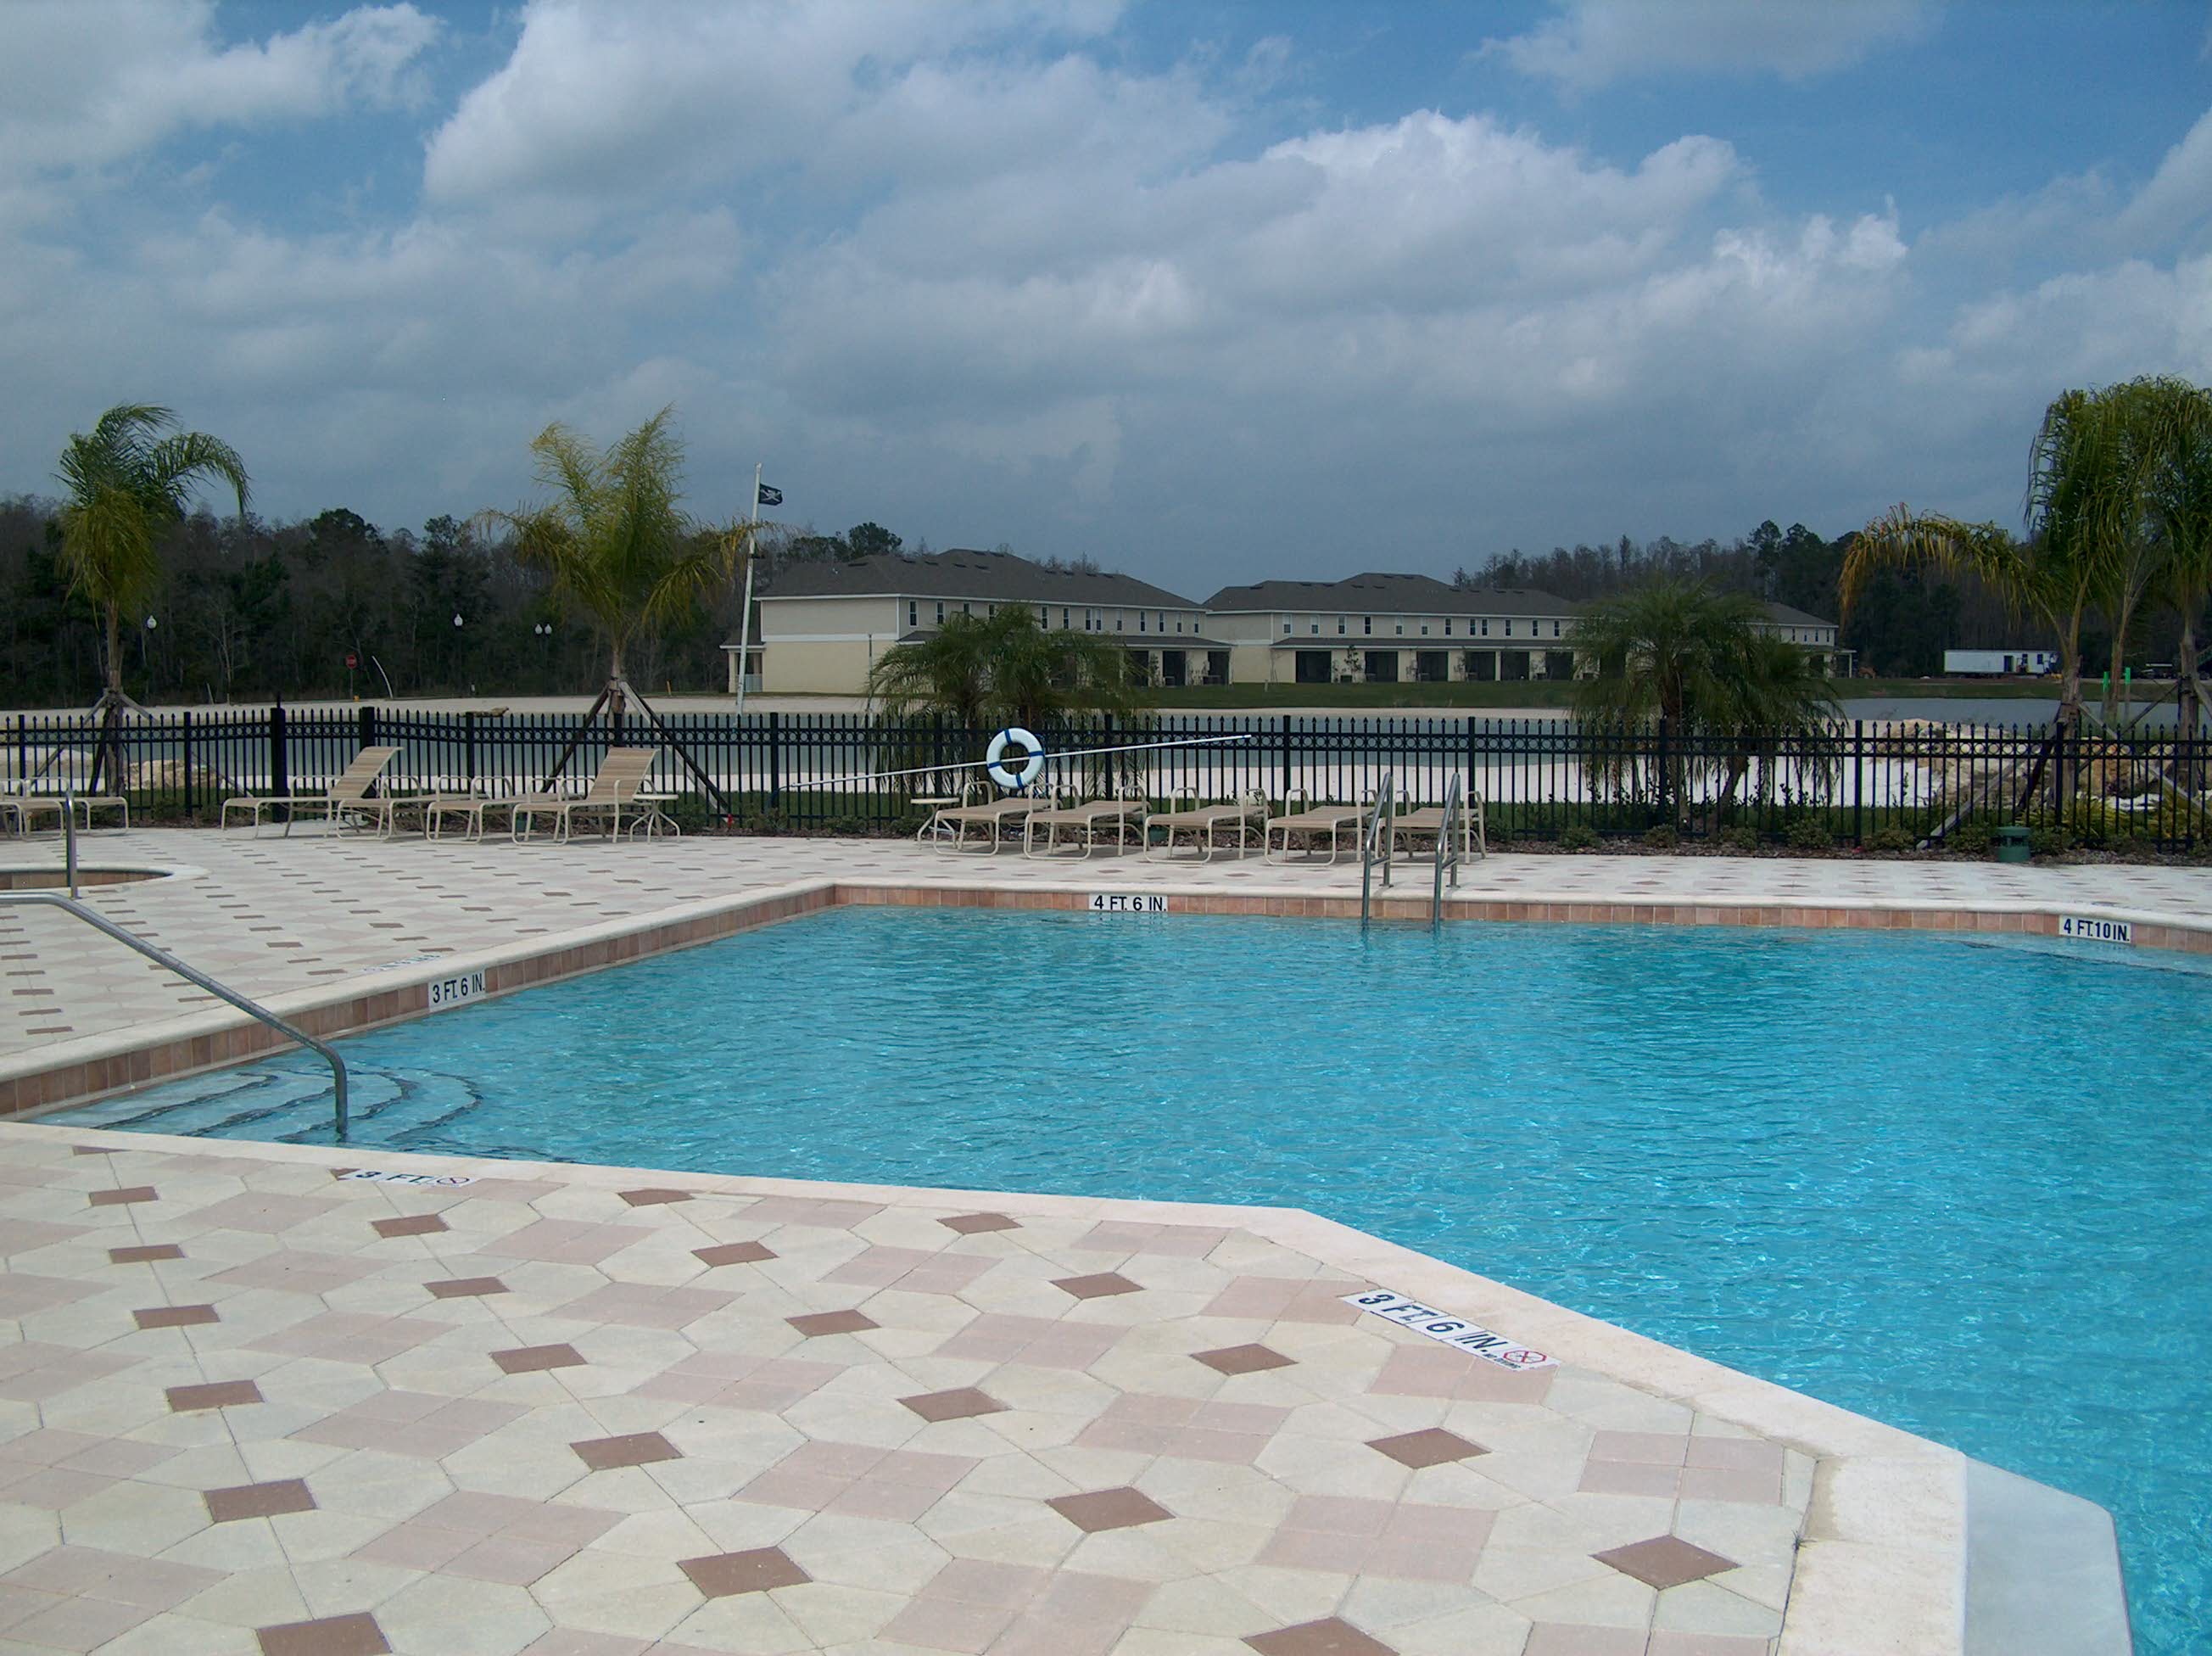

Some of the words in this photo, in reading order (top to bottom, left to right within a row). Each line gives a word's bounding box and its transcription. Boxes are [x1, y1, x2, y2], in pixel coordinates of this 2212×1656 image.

[1094, 895, 1103, 909] 4
[1110, 896, 1127, 911] FT.
[1133, 897, 1142, 911] 6
[1149, 897, 1166, 911] IN.
[2064, 918, 2071, 934] 4
[433, 984, 440, 1003] 3
[444, 979, 458, 1000] FT.
[461, 977, 468, 996] 6
[472, 973, 485, 993] IN.
[1358, 1294, 1395, 1305] 3
[1381, 1305, 1438, 1321] FT.
[1426, 1322, 1466, 1333] 6
[1454, 1334, 1508, 1352] IN.
